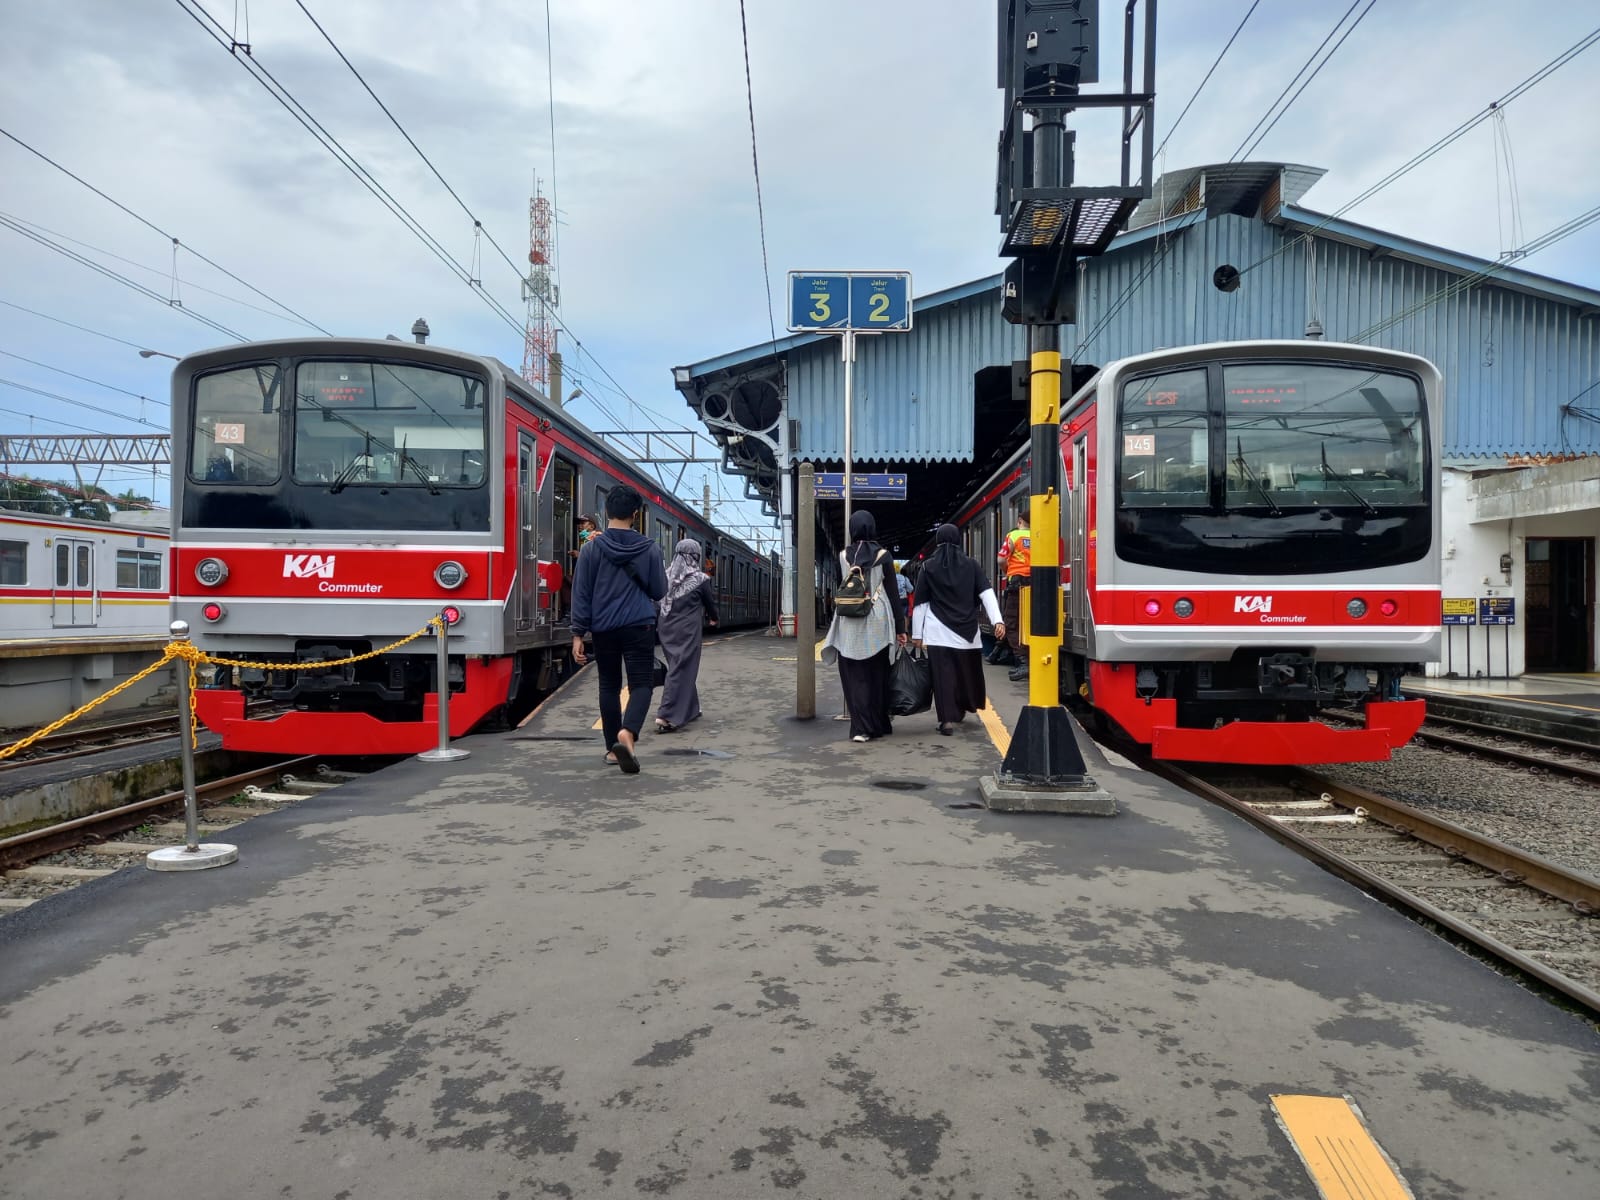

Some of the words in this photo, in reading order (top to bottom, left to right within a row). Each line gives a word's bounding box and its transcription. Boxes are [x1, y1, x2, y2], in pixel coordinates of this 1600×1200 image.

[809, 293, 831, 322] 3
[868, 293, 890, 322] 2
[220, 425, 239, 440] 43
[1128, 438, 1151, 451] 145
[888, 477, 894, 485] 2
[283, 554, 336, 578] KAI
[318, 581, 383, 593] Commuter
[1234, 595, 1273, 613] KAI
[1260, 614, 1307, 623] Commuter
